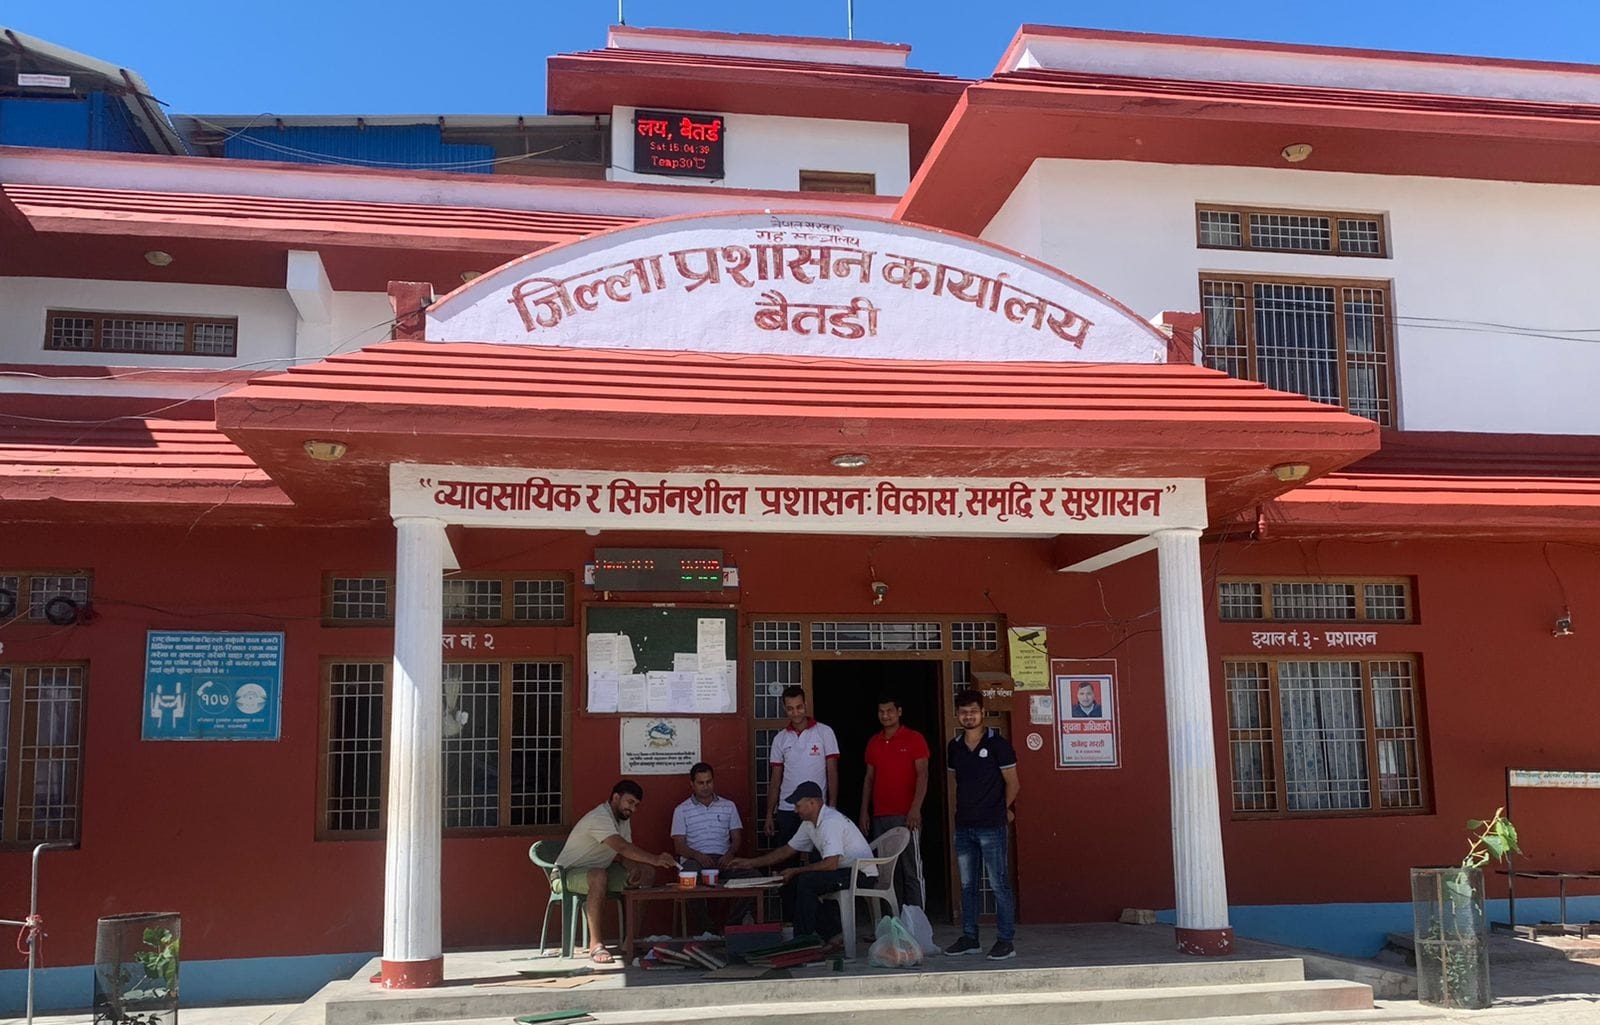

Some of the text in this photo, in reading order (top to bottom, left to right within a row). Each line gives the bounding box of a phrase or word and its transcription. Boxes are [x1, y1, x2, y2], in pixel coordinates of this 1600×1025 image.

[649, 142, 666, 151] Sat
[507, 243, 1095, 350] जिल्ला प्रशासन कार्यालय
[754, 289, 882, 340] बैतडी
[585, 484, 602, 515] र
[607, 478, 749, 516] सिर्जनशील
[876, 481, 964, 519] विकास,
[1039, 487, 1057, 517] र
[484, 633, 495, 650] २
[1324, 631, 1378, 649] प्रशासन
[201, 694, 229, 706] १०७
